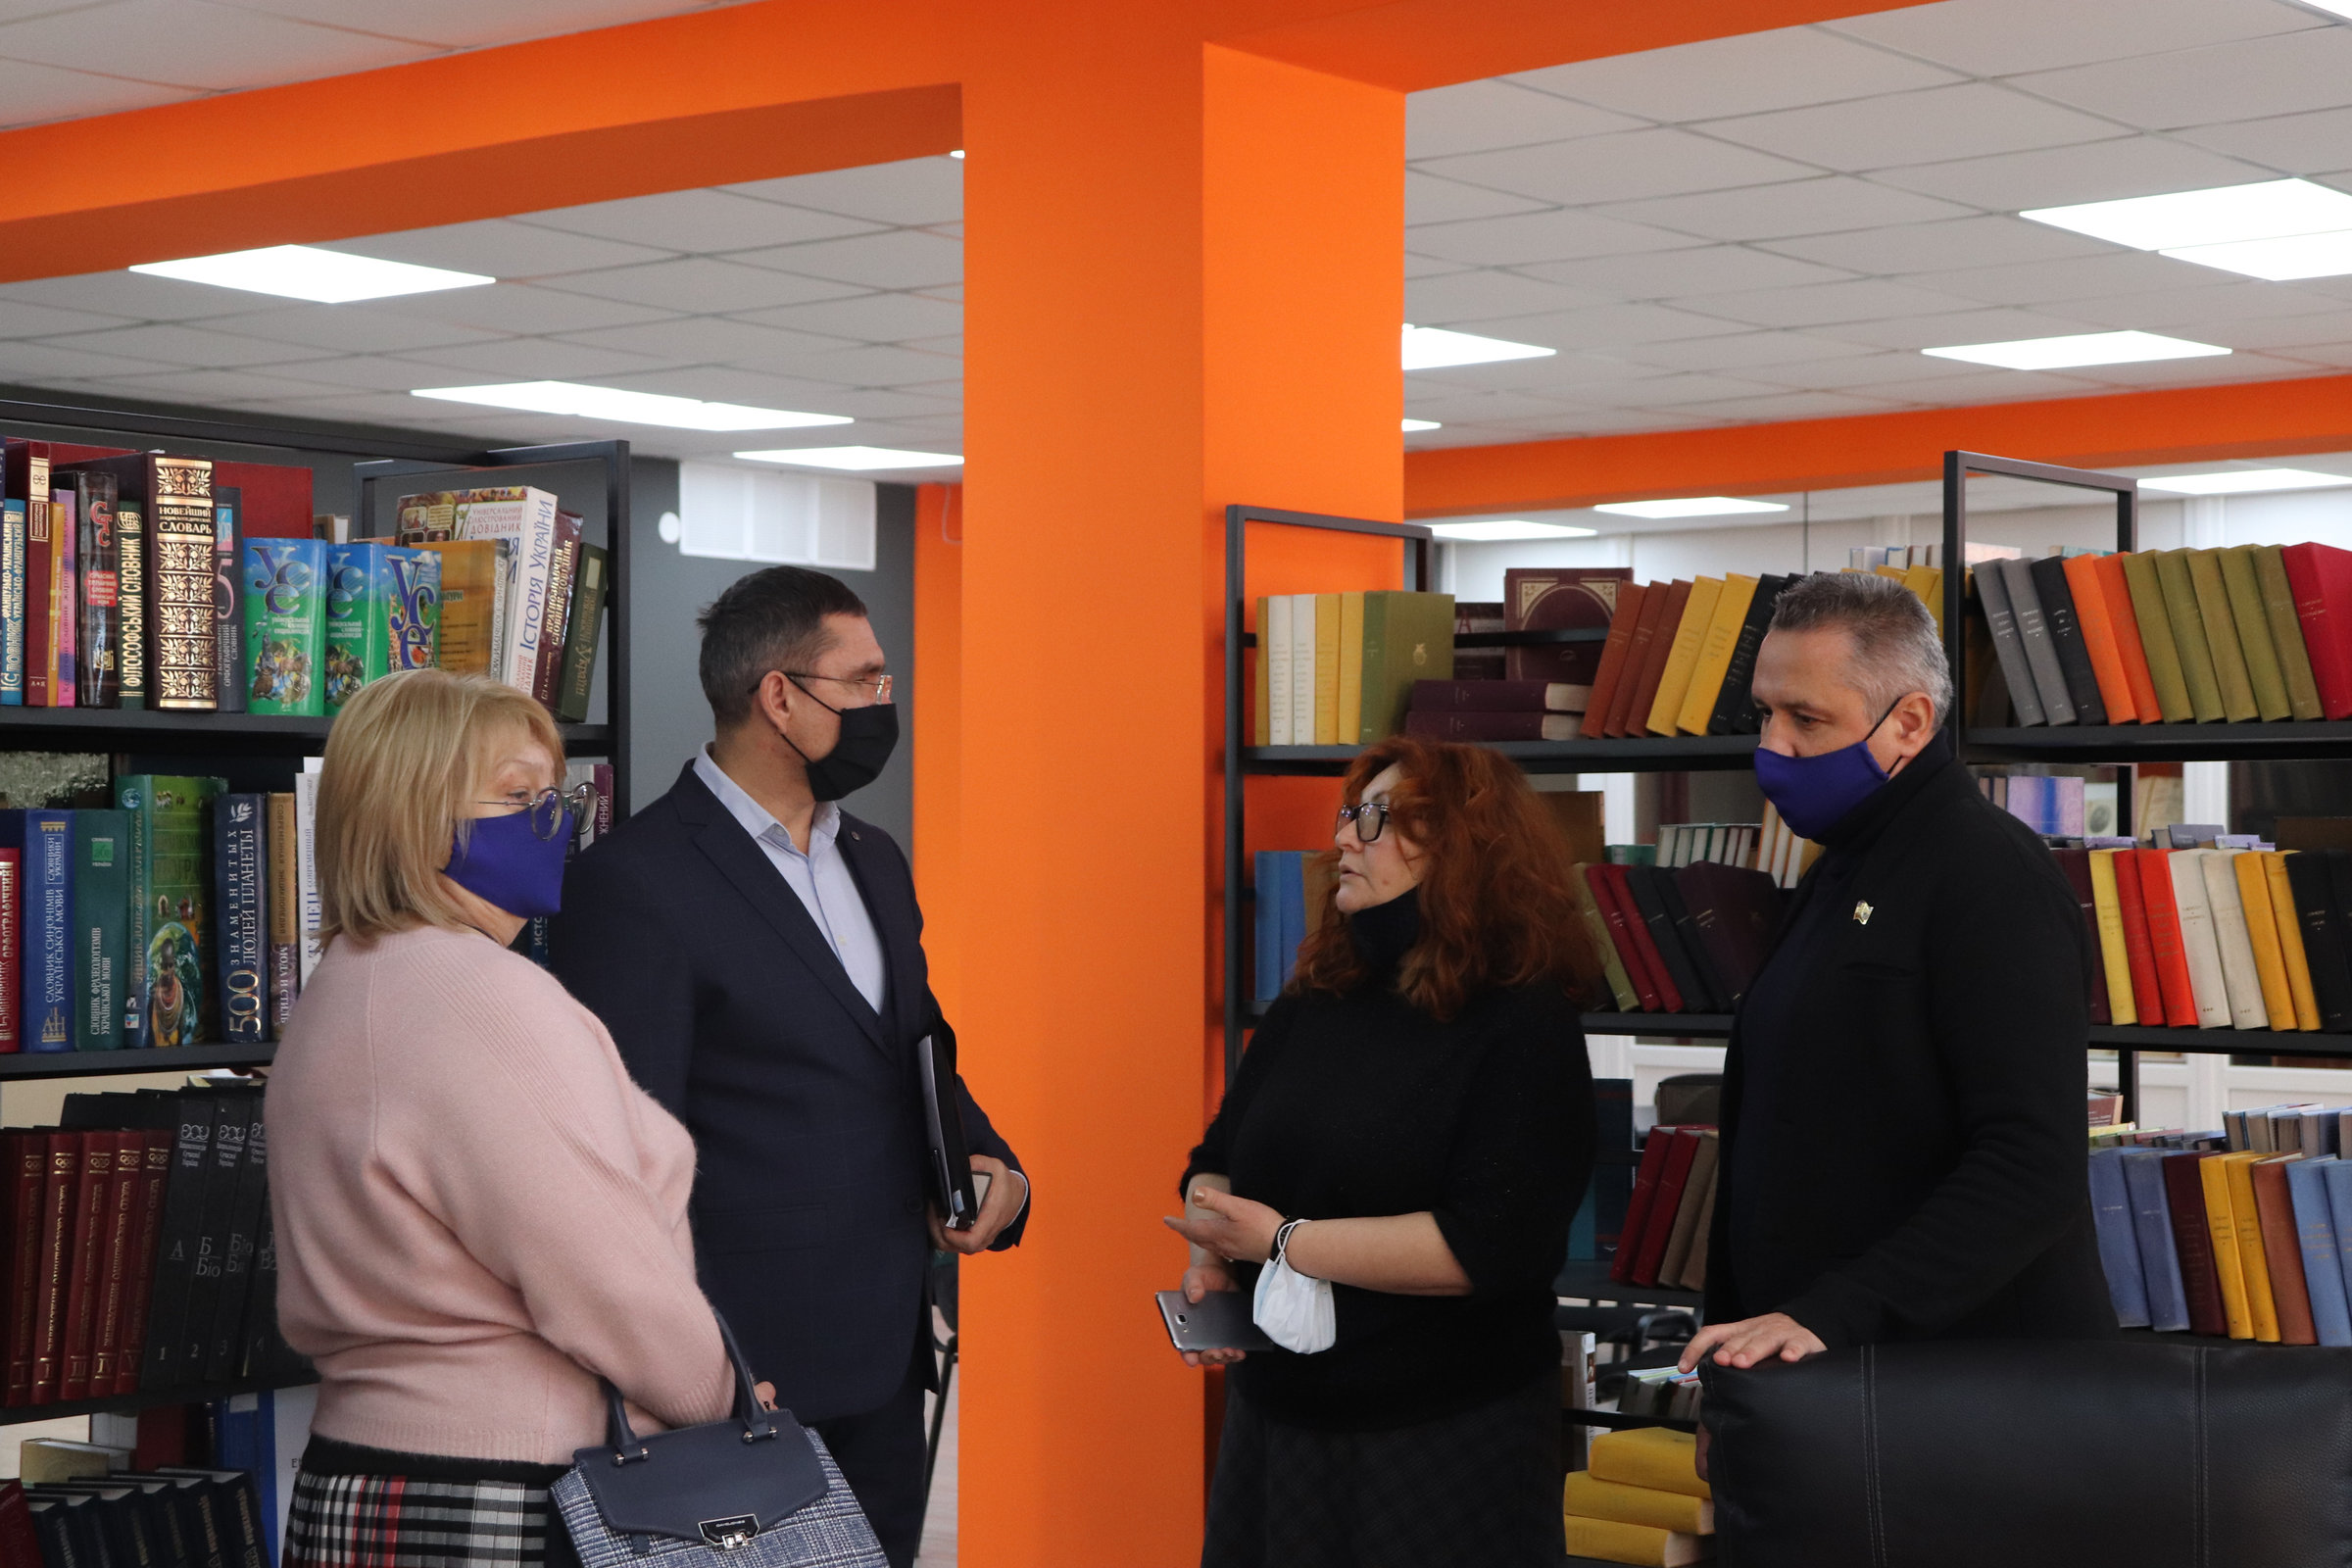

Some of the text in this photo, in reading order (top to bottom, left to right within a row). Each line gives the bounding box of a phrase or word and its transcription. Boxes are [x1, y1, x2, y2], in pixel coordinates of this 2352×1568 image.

[159, 506, 211, 517] НОВЕЙШИЙ
[159, 521, 212, 534] СЛОВАРЬ
[470, 523, 521, 534] ДОВІДНИК
[519, 500, 554, 651] ІСТОРІЯ УКРАЇНИ
[119, 537, 142, 687] ФІЛОСОФСЬКИЙ СЛОВНИК
[598, 794, 609, 834] ЖНЕНИЙ
[227, 831, 240, 965] ЗНАМЕНИТЫХ
[239, 829, 257, 965] ЛЮДЕЙ ПЛАНЕТЫ
[45, 889, 55, 1003] СЛОВНИК СИНОНІМІВ
[53, 889, 65, 1003] УКРАЇНСЬКОЇ МОВИ
[279, 947, 288, 976] МОДА
[90, 927, 101, 1035] СЛОВНИК ФРАЗЕОЛОГІЗМІВ
[101, 956, 111, 1035] УКРАЇНСЬКОЇ МОВИ
[227, 970, 261, 1033] 500
[280, 990, 290, 1024] СТИЛЬ
[172, 1239, 183, 1257] А
[199, 1236, 212, 1255] Б
[196, 1256, 220, 1277] Біо
[159, 1347, 166, 1360] 1
[191, 1344, 199, 1357] 2
